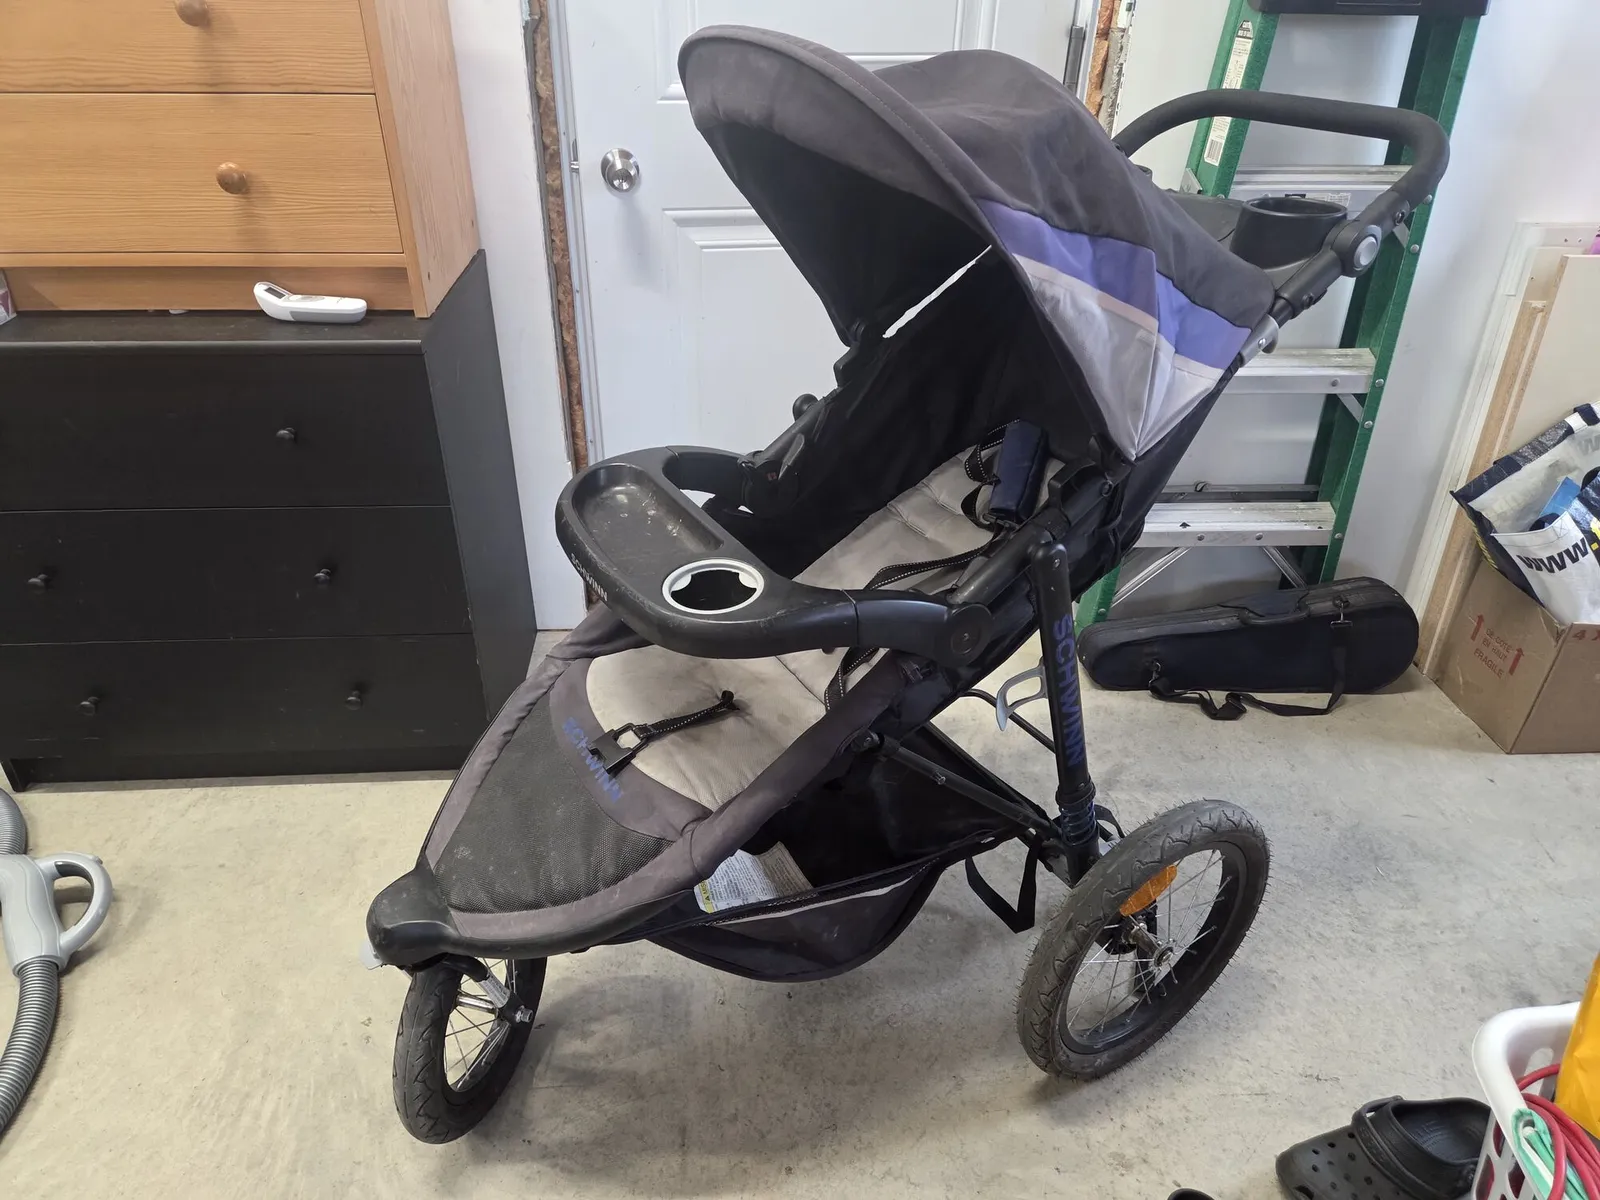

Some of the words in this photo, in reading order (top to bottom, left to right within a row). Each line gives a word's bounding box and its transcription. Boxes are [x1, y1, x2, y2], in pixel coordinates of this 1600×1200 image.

[571, 553, 608, 602] SCHWINN
[1474, 648, 1504, 679] FRAGILE
[1053, 613, 1084, 767] SCHWINN
